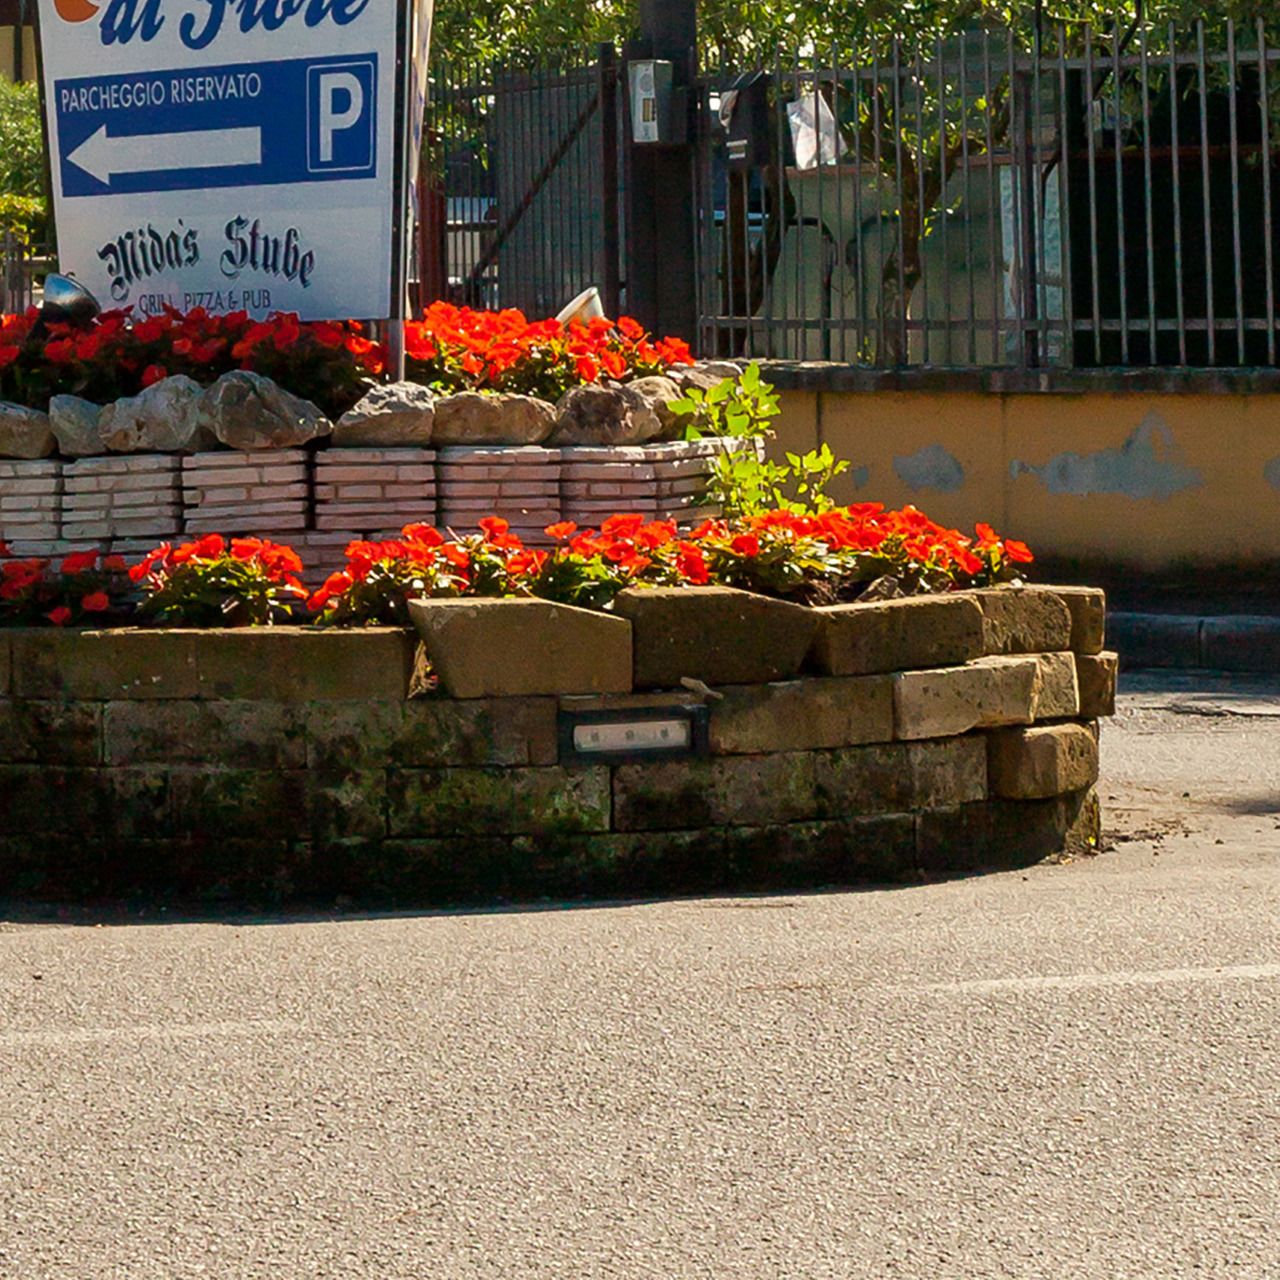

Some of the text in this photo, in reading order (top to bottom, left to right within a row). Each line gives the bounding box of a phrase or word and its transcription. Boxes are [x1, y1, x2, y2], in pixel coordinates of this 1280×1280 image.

[60, 72, 262, 112] PARCHEGGIO RISERVATO
[319, 72, 364, 162] P
[219, 214, 315, 289] Stube
[183, 291, 225, 312] PIZZA
[227, 290, 239, 310] &
[242, 289, 271, 310] PUB
